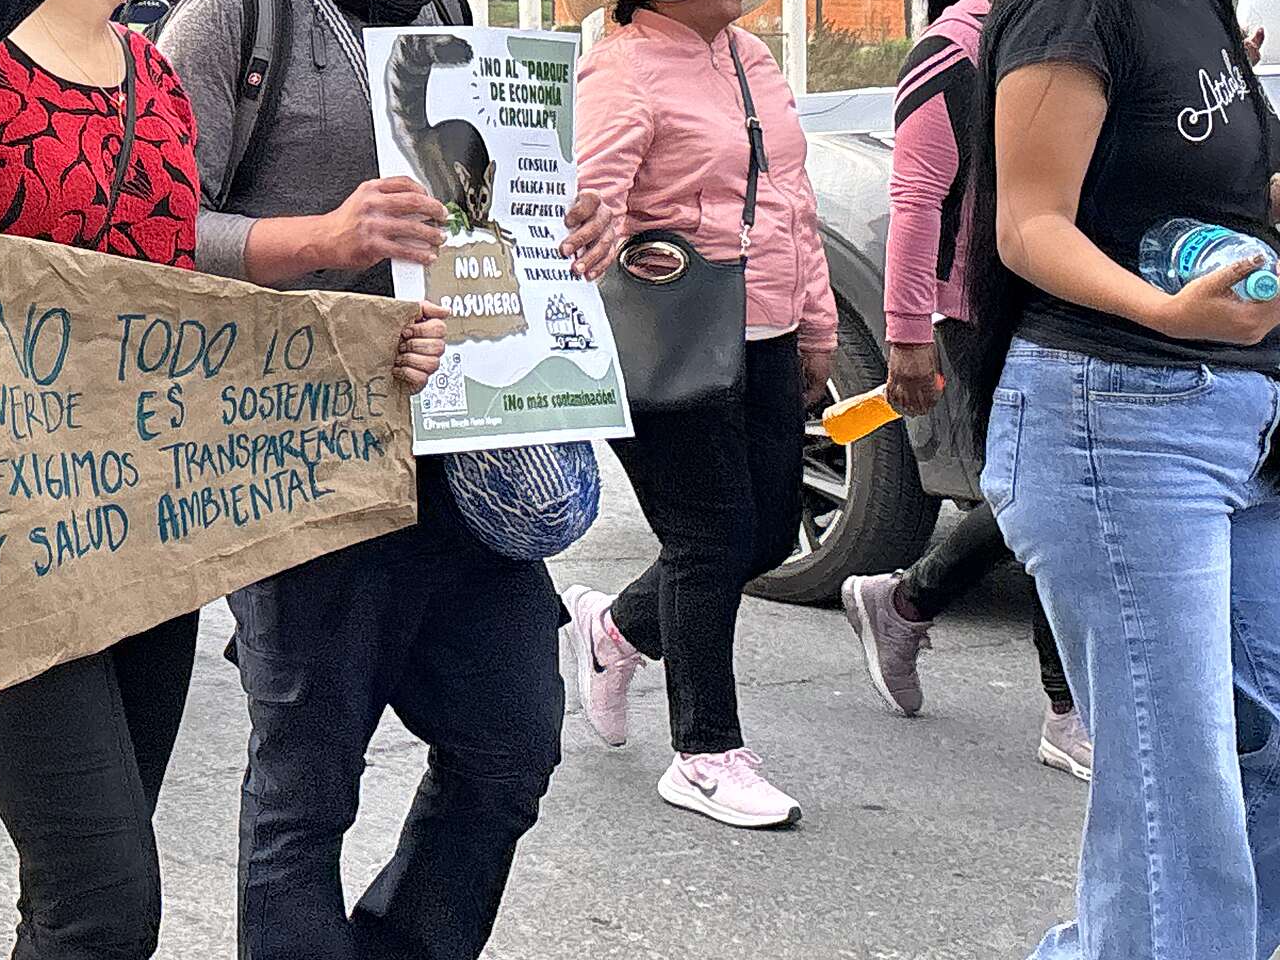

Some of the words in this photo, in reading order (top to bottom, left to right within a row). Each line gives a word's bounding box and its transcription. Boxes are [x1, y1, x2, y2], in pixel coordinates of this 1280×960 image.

[506, 59, 519, 79] AL
[490, 82, 506, 101] DE
[509, 83, 562, 106] ECONOMÍA
[455, 256, 479, 279] NO
[483, 256, 503, 279] AL
[440, 293, 521, 317] BASURERO
[116, 313, 237, 381] TODO
[263, 324, 314, 375] LO
[135, 383, 184, 440] ES
[221, 376, 389, 426] SOSTENIBLE
[503, 394, 524, 411] ¡No
[527, 392, 549, 408] más
[159, 421, 386, 489] TRANSPARENCIA
[29, 503, 130, 577] SALUD
[157, 461, 336, 545] AMBIENTAL
